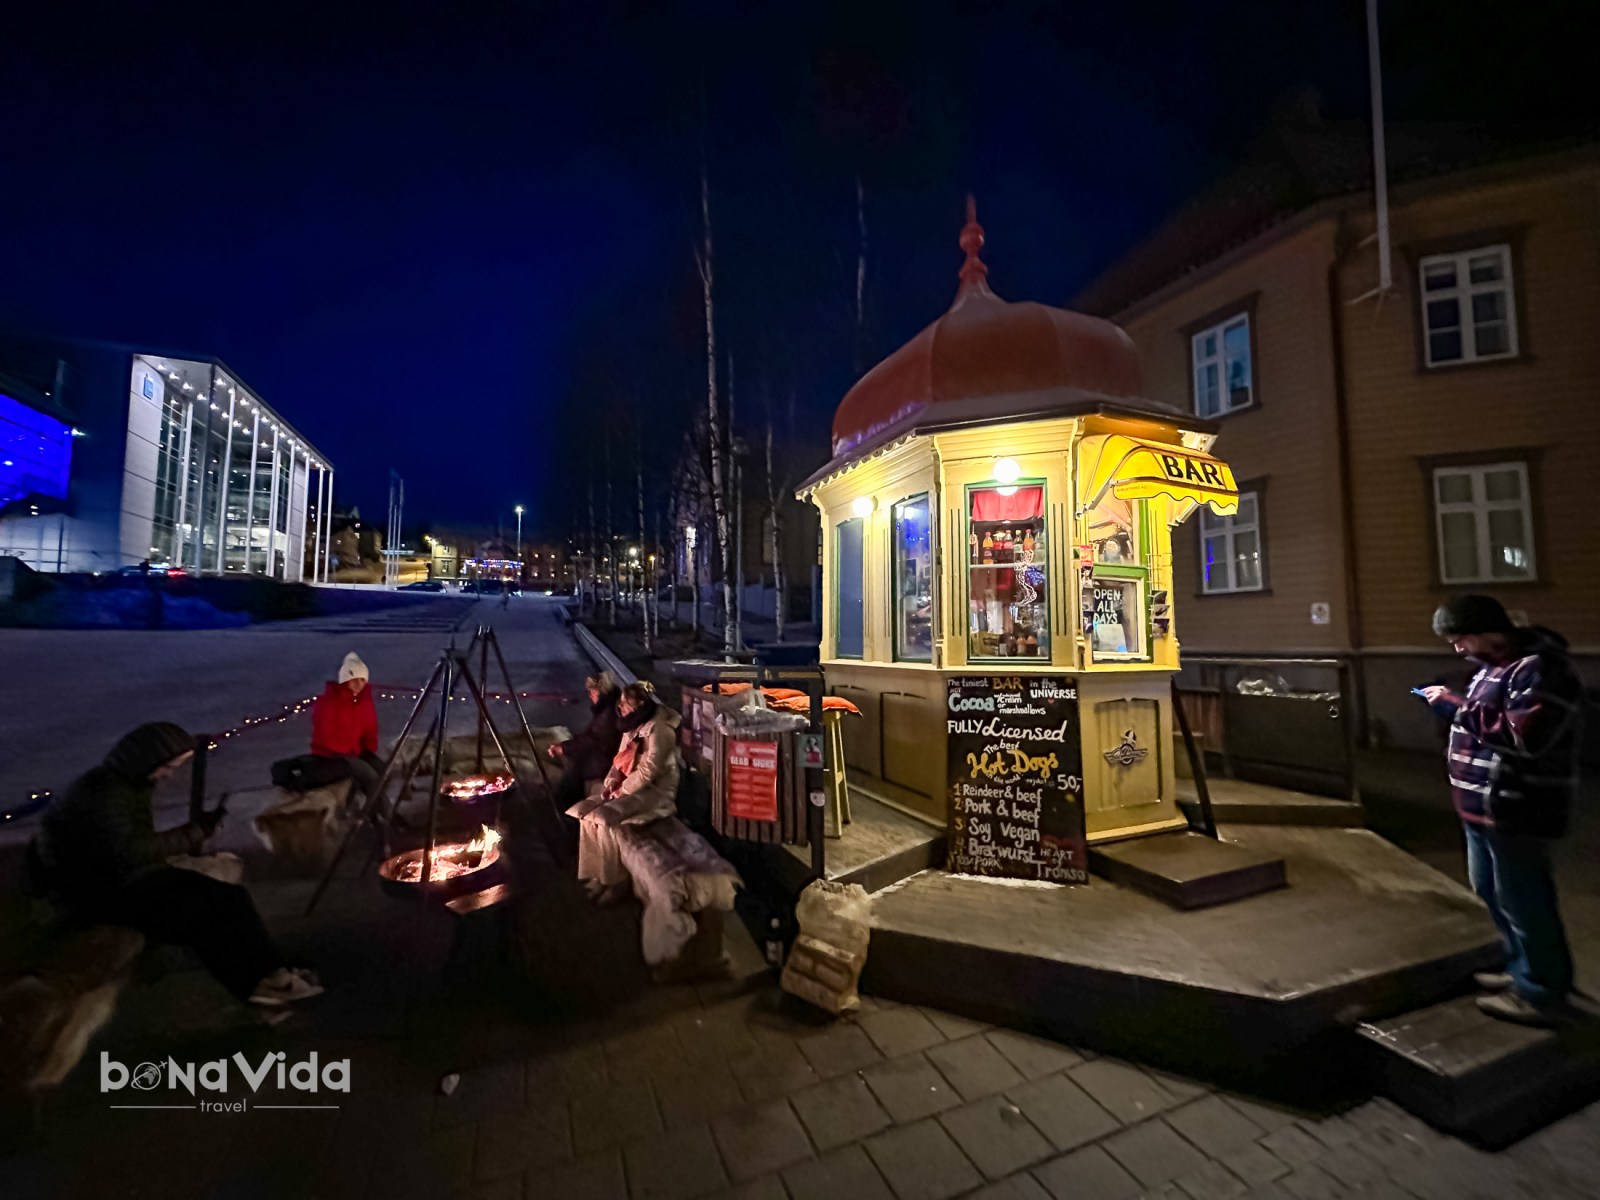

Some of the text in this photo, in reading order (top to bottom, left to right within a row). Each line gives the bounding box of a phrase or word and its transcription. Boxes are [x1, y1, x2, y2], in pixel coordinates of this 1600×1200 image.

[1161, 454, 1224, 486] BAR
[1093, 589, 1121, 600] OPEN
[1097, 600, 1116, 613] ALL
[1093, 612, 1118, 625] DAYS
[961, 677, 989, 687] tiniest
[992, 677, 1024, 690] BAR
[1030, 680, 1038, 688] in
[1041, 678, 1058, 690] the
[948, 693, 995, 712] Cocoa
[1030, 688, 1077, 699] UNIVERSE
[999, 703, 1046, 715] marshmallows
[947, 717, 1068, 743] FULLY Licensed
[983, 738, 1020, 755] The best
[967, 749, 1059, 779] Hot Dogs
[963, 783, 1005, 798] Reindeer
[1016, 786, 1043, 811] beef
[965, 798, 992, 814] Pork
[996, 799, 1009, 817] &
[1012, 802, 1041, 828] beef
[968, 817, 992, 842] Soy
[1000, 822, 1040, 849] Vegan
[968, 837, 1036, 864] Bratwurst
